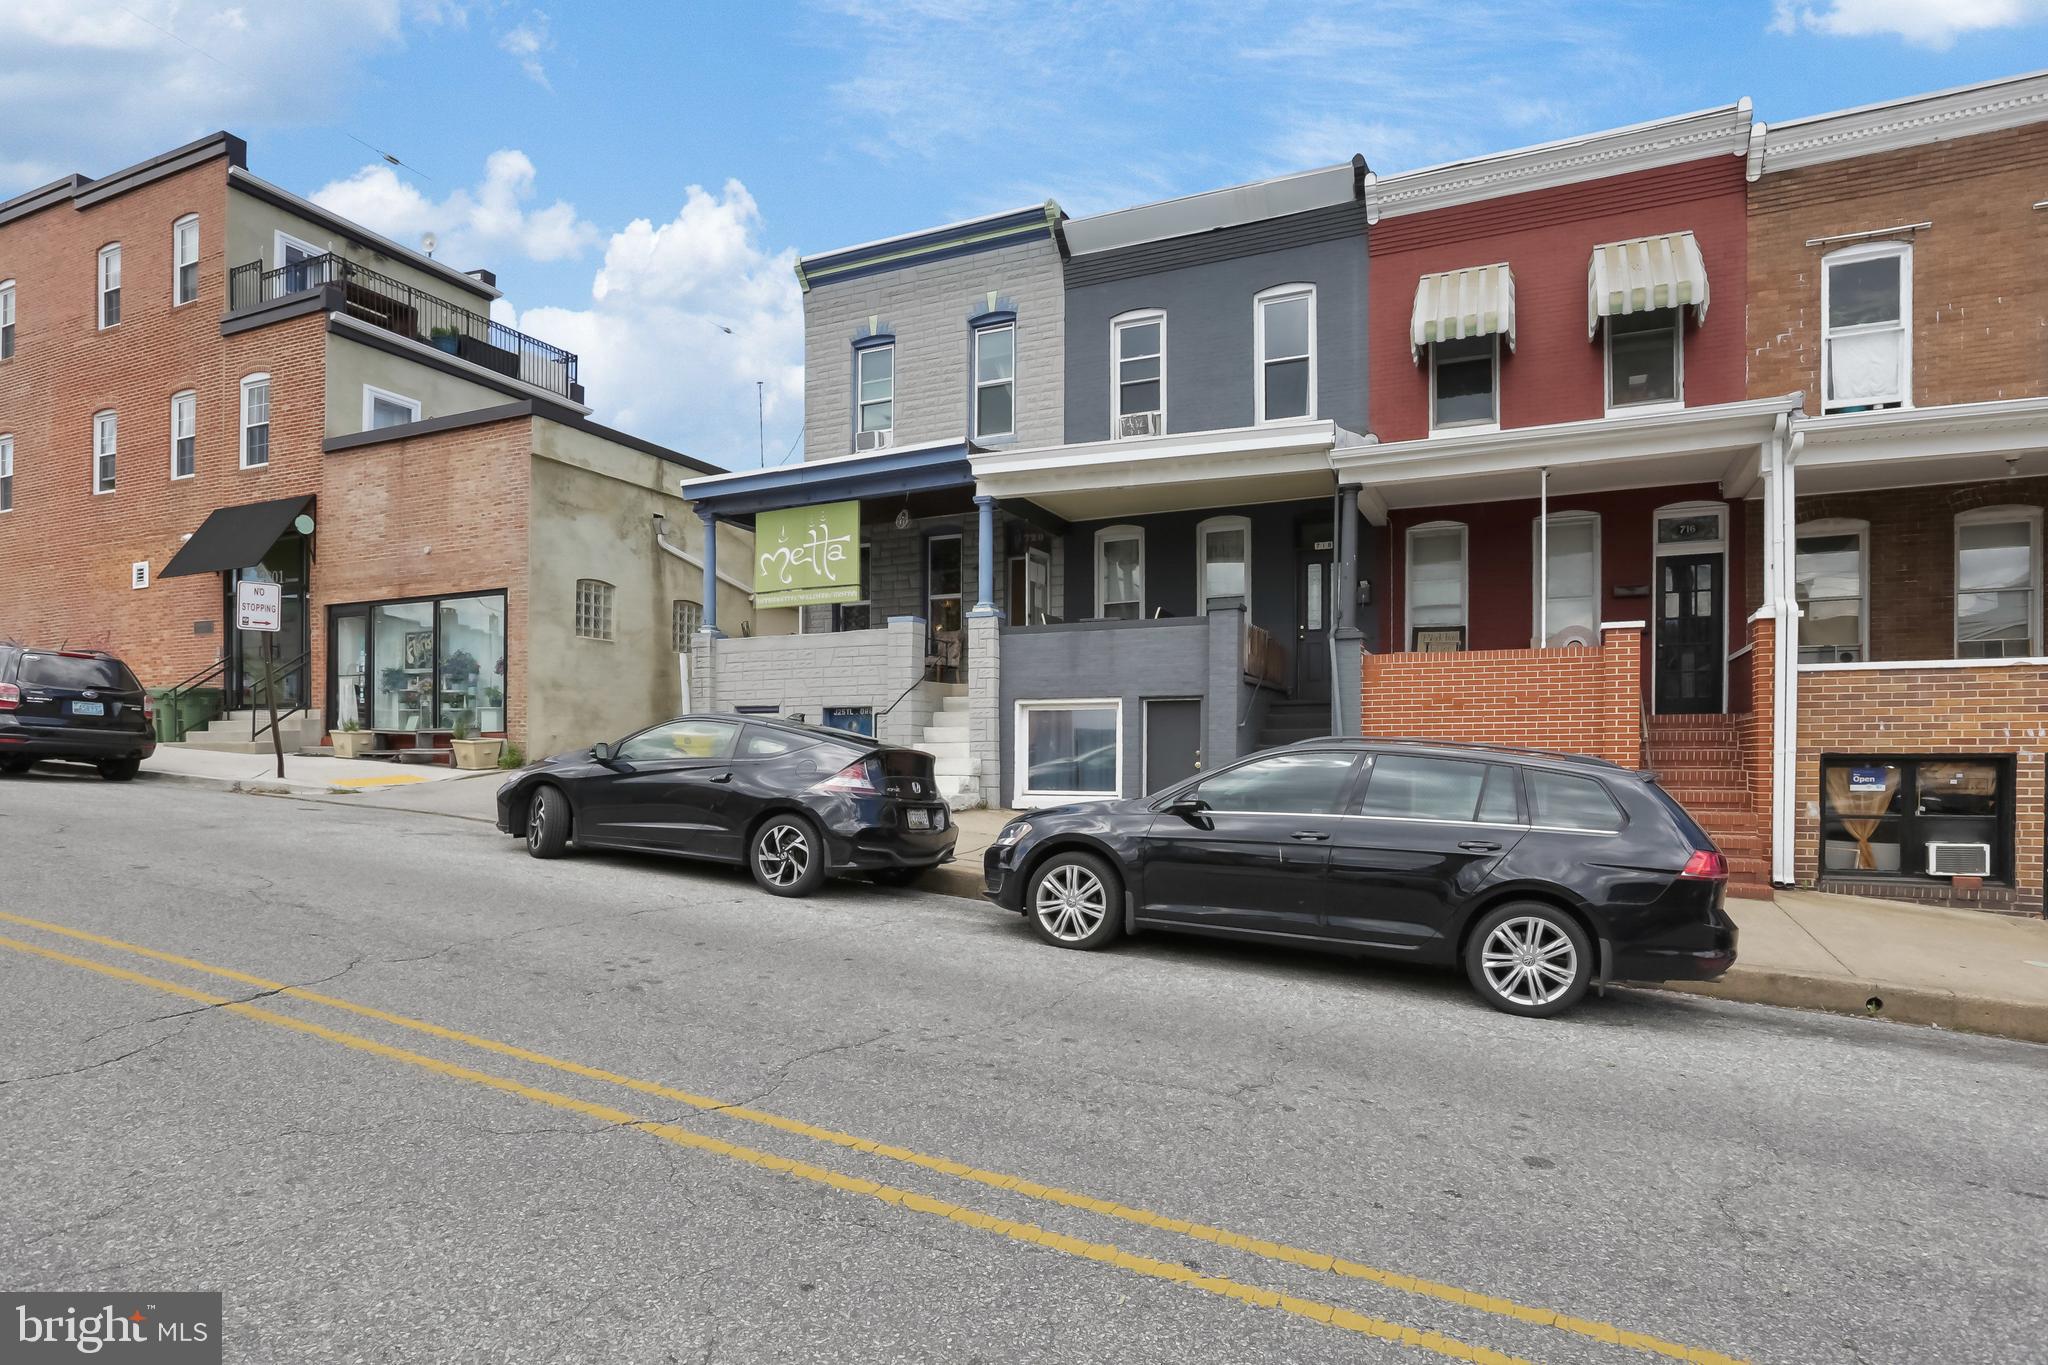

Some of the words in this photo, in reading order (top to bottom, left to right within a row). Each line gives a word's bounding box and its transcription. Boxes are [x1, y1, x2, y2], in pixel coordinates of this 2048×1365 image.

[1680, 525, 1696, 534] 716
[254, 587, 265, 596] NO
[241, 602, 276, 613] STOPPING
[1853, 775, 1875, 783] Open
